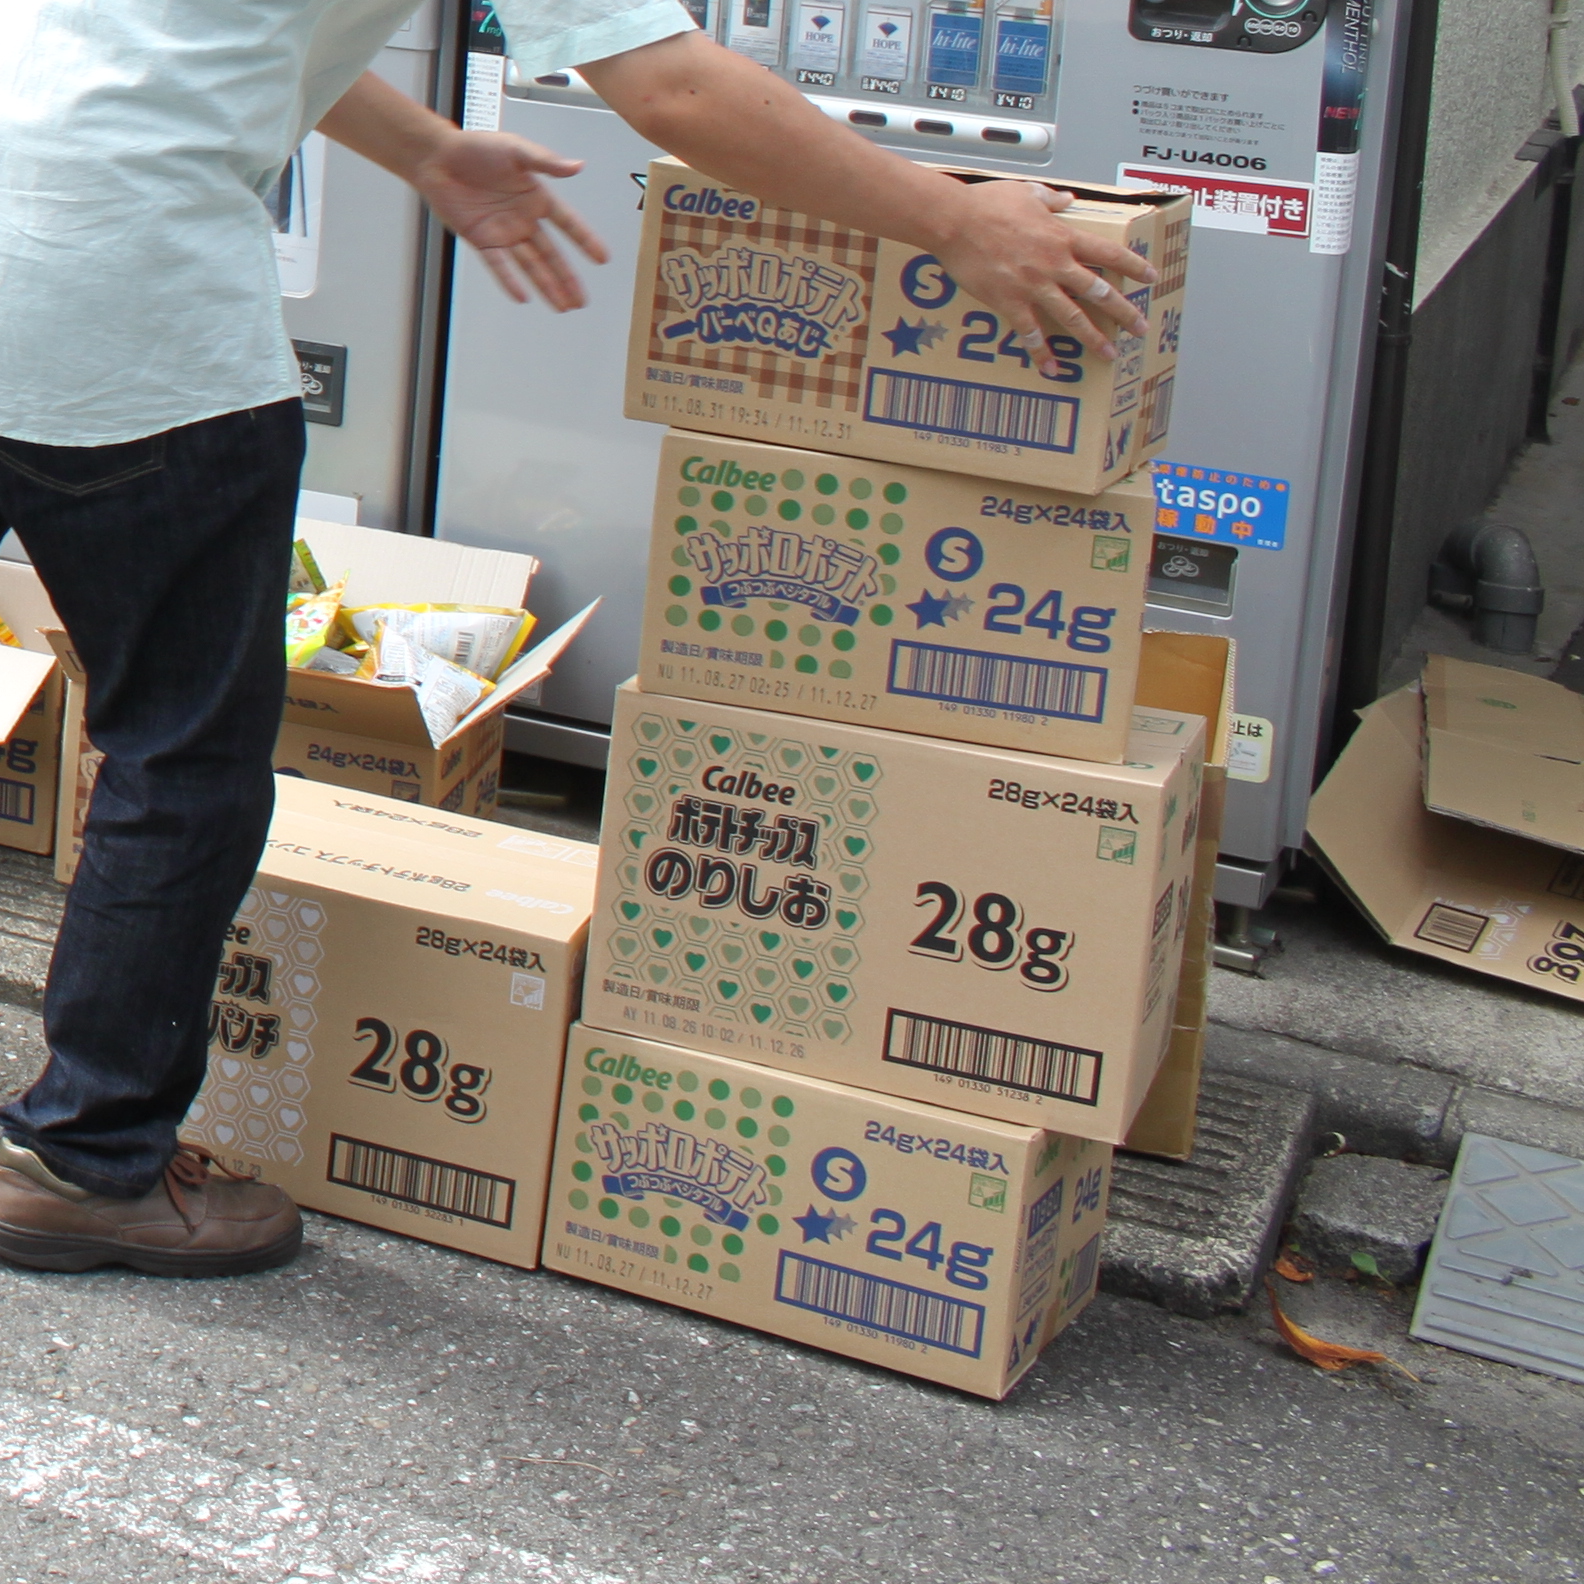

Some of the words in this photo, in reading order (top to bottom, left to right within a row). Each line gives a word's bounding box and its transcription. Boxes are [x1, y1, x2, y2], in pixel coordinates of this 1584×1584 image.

[805, 31, 833, 42] HOPE
[872, 39, 900, 50] HOPE
[933, 29, 976, 48] hi-lite
[999, 36, 1044, 56] hi-lite
[1151, 28, 1212, 42] おつり・返却
[1133, 84, 1229, 102] つづけ買いができます
[1142, 144, 1267, 170] FJ-U4006
[663, 183, 755, 220] Calbee
[663, 244, 864, 330] サッポロポテト
[698, 310, 823, 354] バーベQあじ
[646, 367, 745, 395] 製造日/賞味期限
[662, 395, 724, 420] 11.08.31
[788, 414, 853, 440] 11.12.31
[913, 430, 932, 443] 149
[937, 434, 970, 450] 01330
[680, 455, 776, 492] Calbee
[980, 496, 1132, 533] 24g×24袋入
[1157, 478, 1261, 519] taspo
[687, 527, 880, 602] サッポロポテト
[729, 581, 832, 610] つぶつぶベジタブル
[983, 582, 1117, 654] 24g
[661, 639, 763, 668] 製造日/賞味期限
[680, 665, 745, 690] 11.08.27
[749, 676, 790, 697] 02:25
[811, 685, 878, 711] 11.12.27
[937, 700, 958, 713] 149
[962, 706, 996, 720] 01330
[1002, 711, 1035, 725] 11980
[701, 765, 797, 807] Calbee
[988, 778, 1140, 826] 28g×24袋入
[669, 797, 826, 869] ポテトチップス
[645, 849, 831, 931] のりしお
[415, 926, 547, 973] 28g×24袋入
[907, 879, 1073, 991] 28g
[602, 977, 701, 1013] 製造日/賞味期限
[749, 1031, 806, 1059] 11.12.26
[349, 1016, 492, 1123] 28g
[582, 1046, 673, 1091] Calbee
[592, 1123, 768, 1209] サッポロポテト
[863, 1119, 1010, 1176] 24g×24袋入
[628, 1173, 724, 1212] つぶつぶベジタブル
[564, 1220, 660, 1260] 製造日/賞味期限
[865, 1207, 994, 1291] 24g
[651, 1270, 713, 1301] 11.12.27
